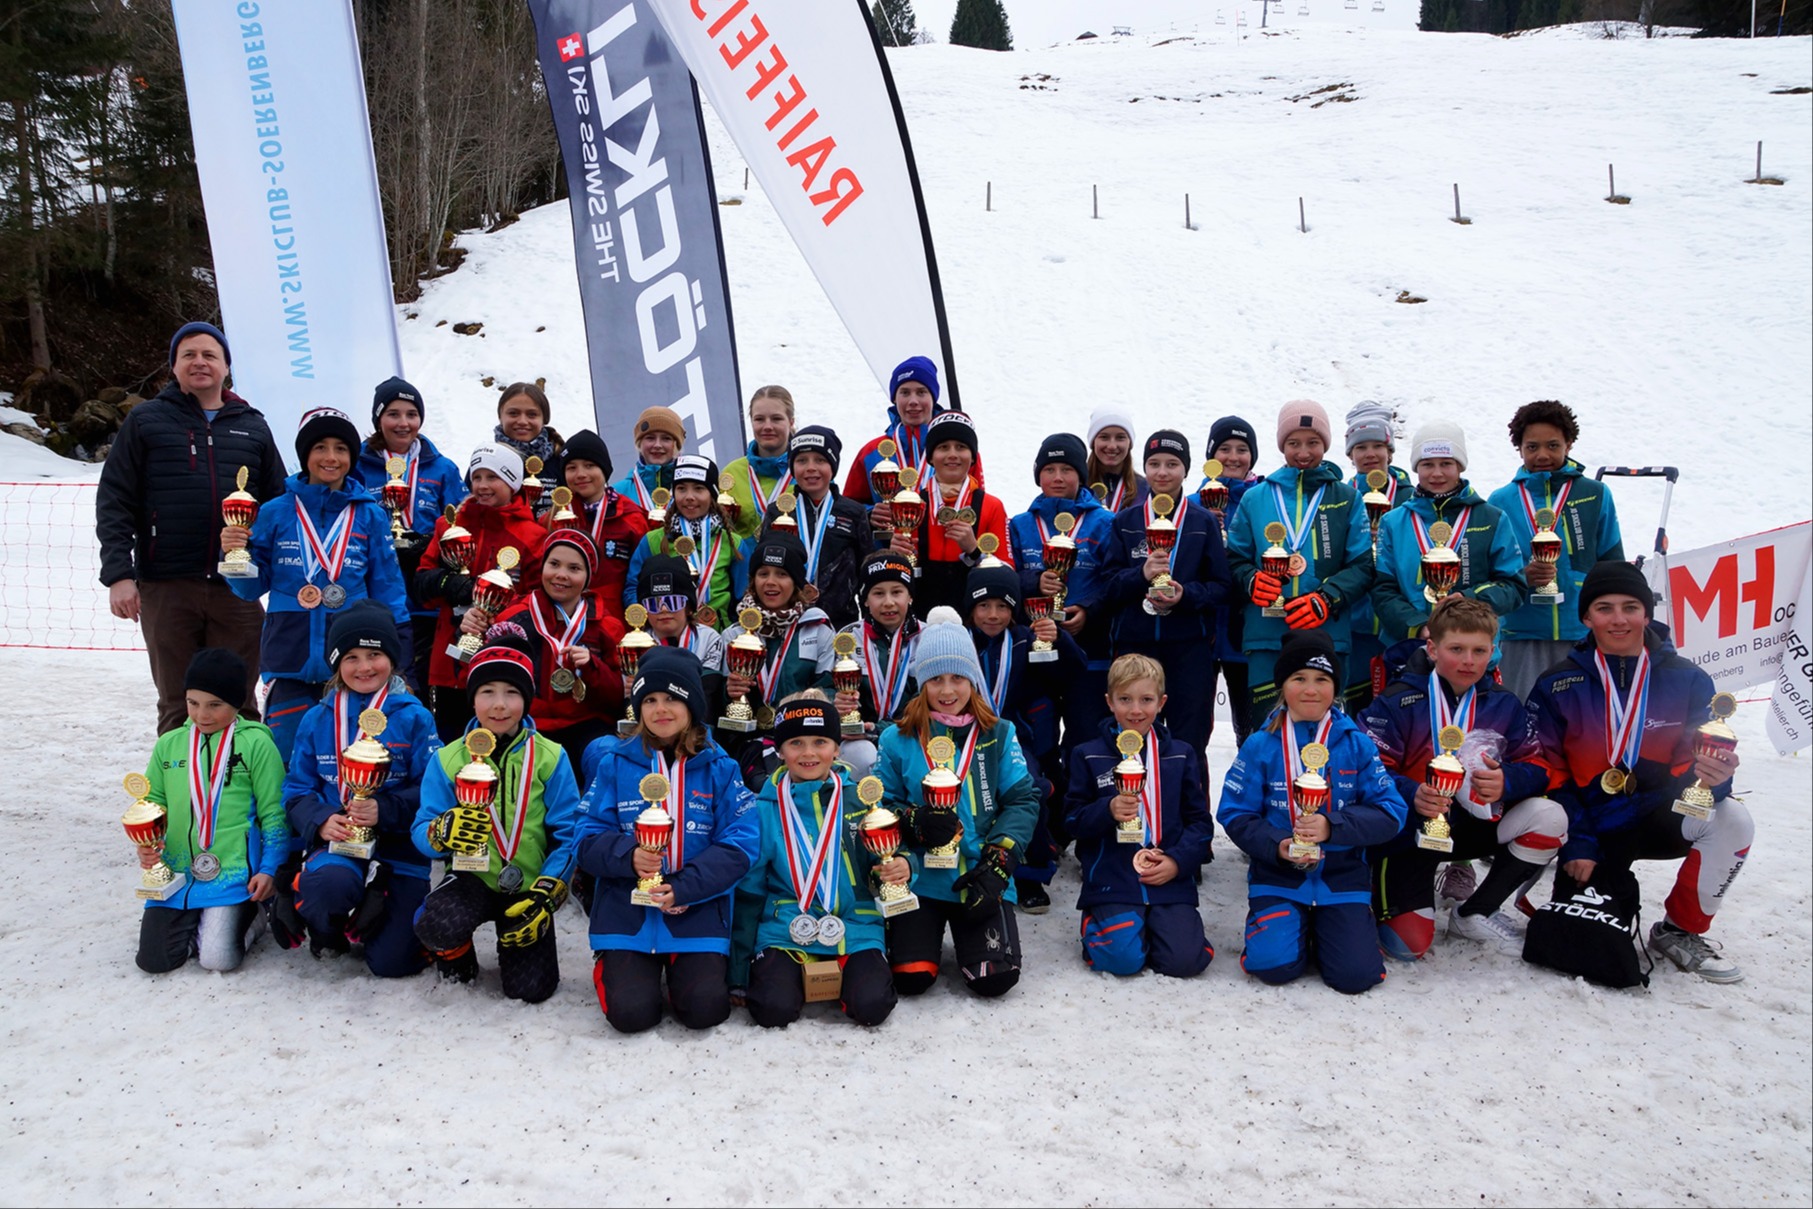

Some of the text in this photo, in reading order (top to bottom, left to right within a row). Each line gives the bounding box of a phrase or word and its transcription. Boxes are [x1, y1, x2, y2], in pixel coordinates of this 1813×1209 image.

[797, 436, 823, 444] Sunrise
[1725, 643, 1748, 658] am
[784, 707, 824, 720] MIGROS
[979, 761, 989, 790] SKICLUB
[981, 790, 993, 812] HASLE
[1712, 861, 1744, 898] helvetia
